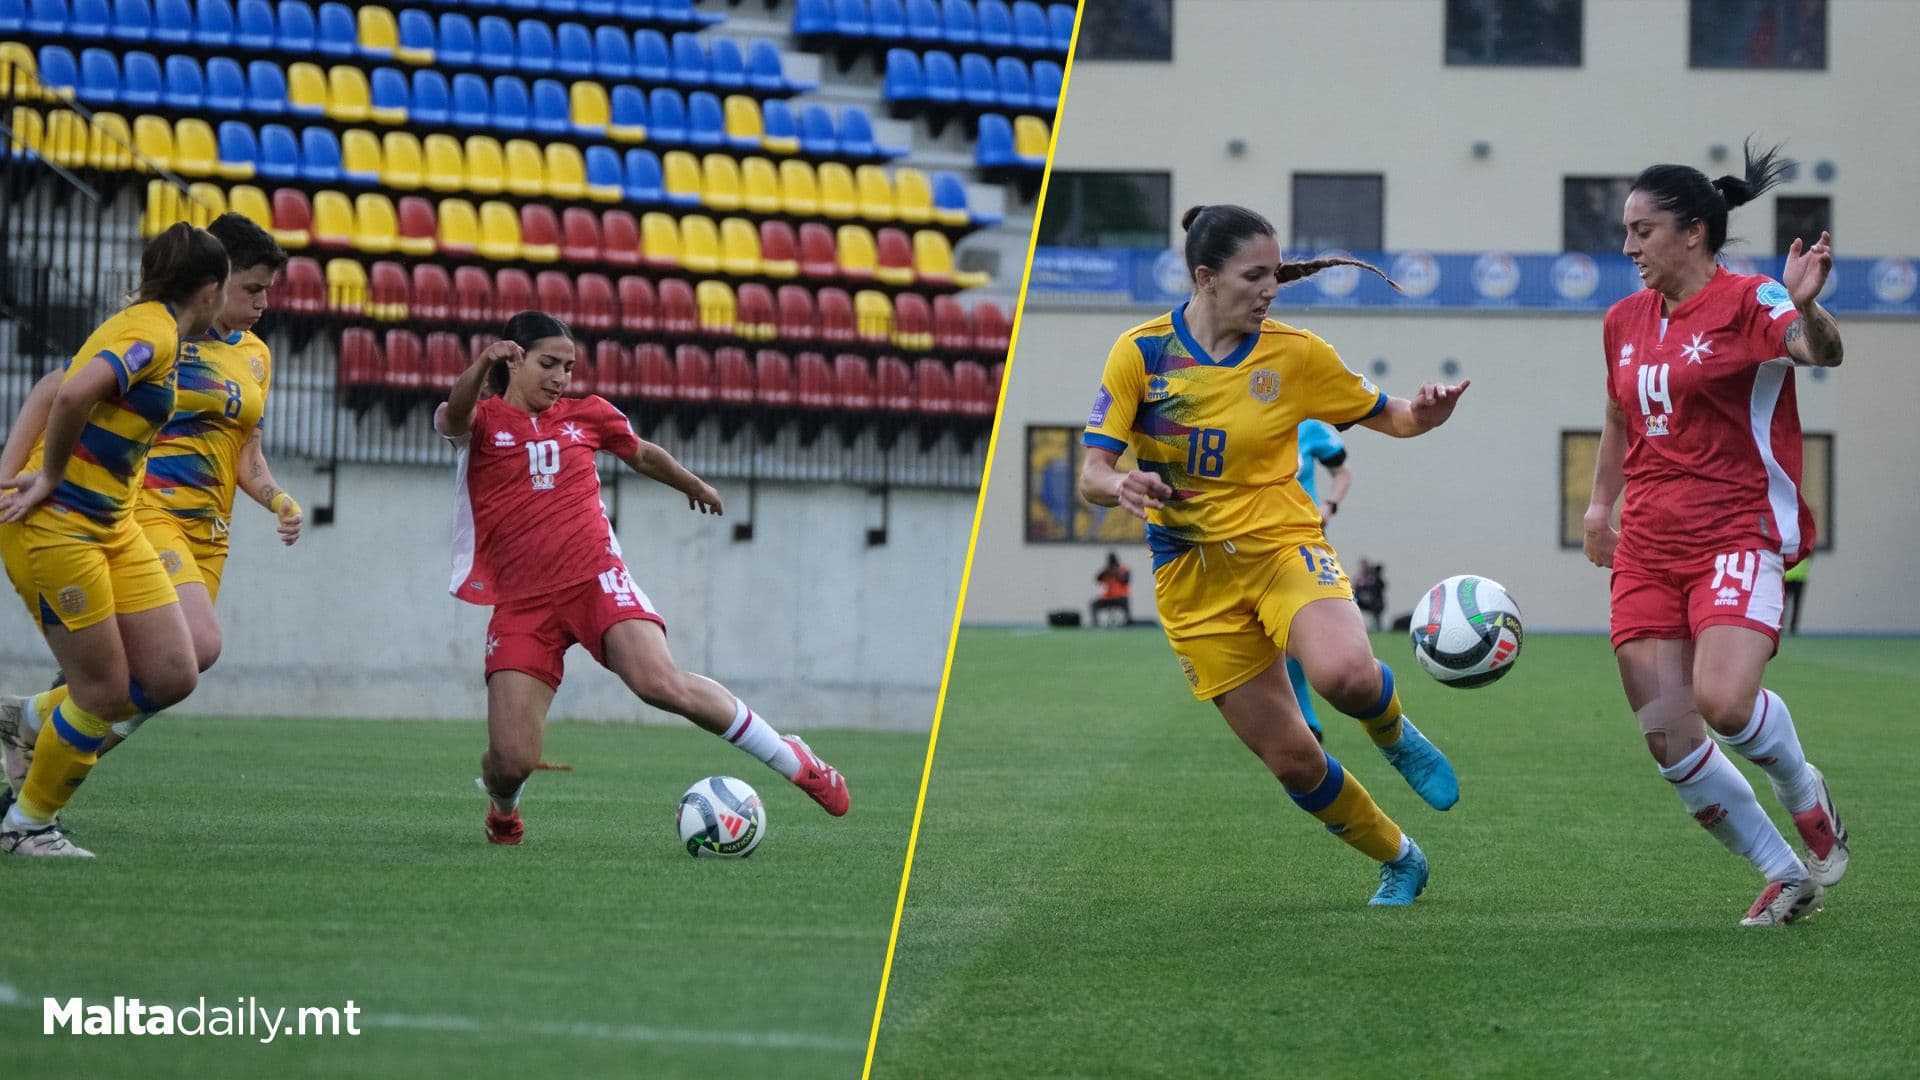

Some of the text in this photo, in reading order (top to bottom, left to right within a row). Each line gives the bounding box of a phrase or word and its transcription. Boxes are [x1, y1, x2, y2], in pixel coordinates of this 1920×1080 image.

[225, 379, 242, 419] 8
[1637, 363, 1673, 416] 14
[525, 439, 560, 475] 10
[1186, 427, 1228, 478] 18
[1710, 551, 1756, 592] 14
